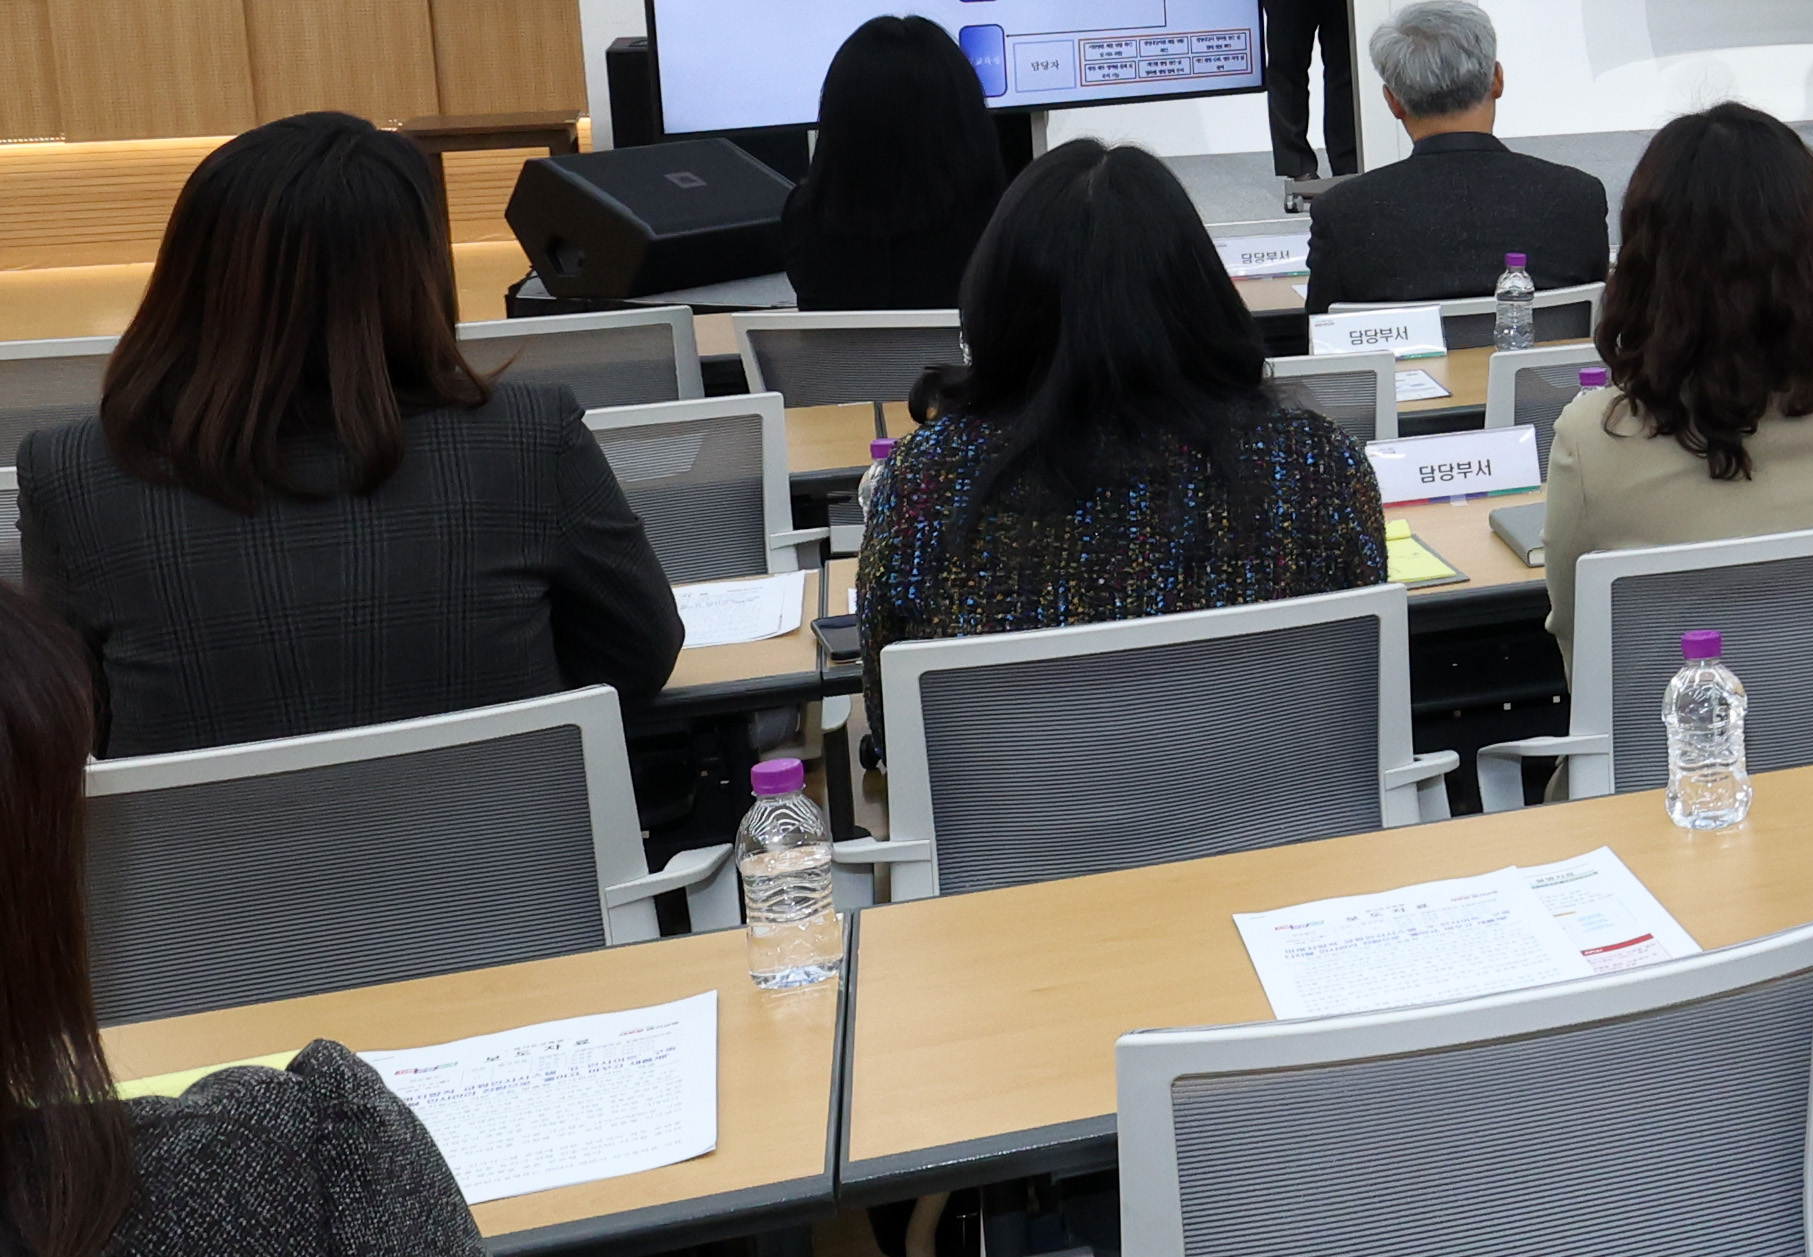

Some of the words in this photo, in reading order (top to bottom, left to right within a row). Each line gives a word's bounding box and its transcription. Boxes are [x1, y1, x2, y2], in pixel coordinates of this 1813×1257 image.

[1031, 60, 1059, 71] 담당자
[1241, 250, 1290, 263] 담당부서
[1349, 326, 1409, 345] 담당부서
[1419, 459, 1492, 483] 담당부서
